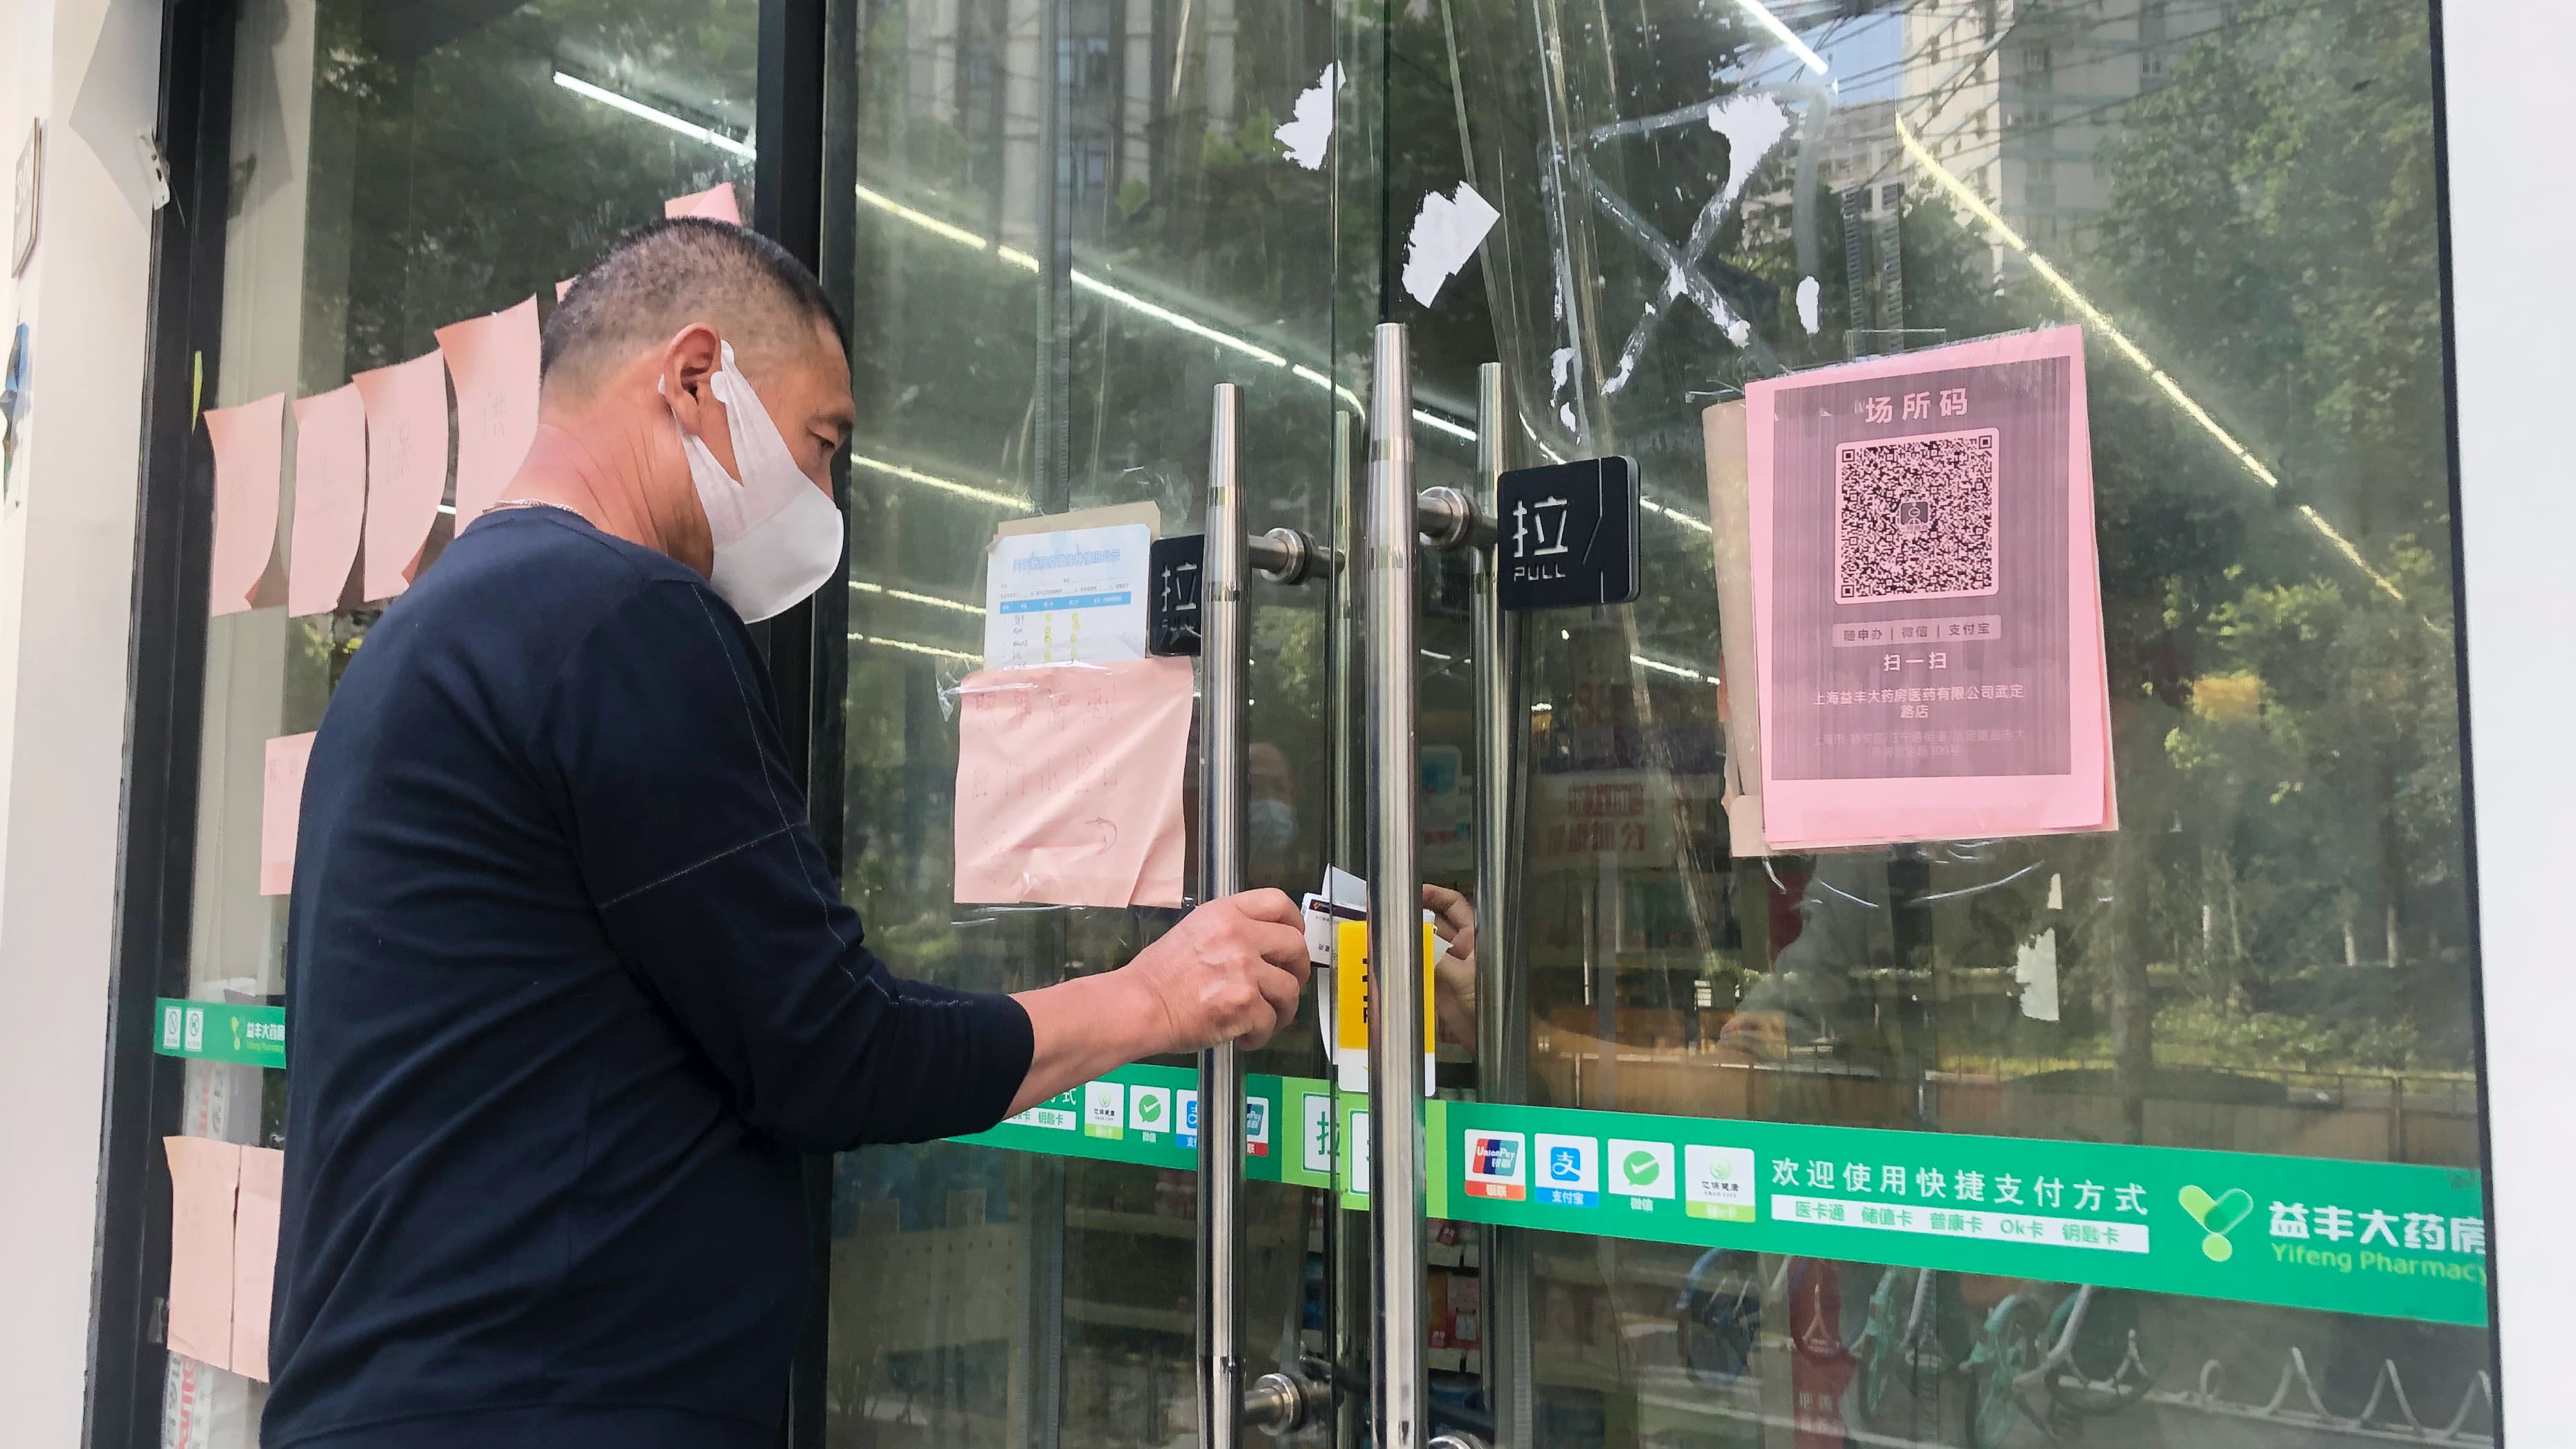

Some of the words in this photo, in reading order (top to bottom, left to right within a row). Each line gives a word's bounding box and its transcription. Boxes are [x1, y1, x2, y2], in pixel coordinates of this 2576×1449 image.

[1865, 388, 1968, 424] 场所码
[1512, 495, 1568, 558] 拉
[1514, 563, 1566, 582] PULL
[1161, 561, 1197, 612] 拉
[1844, 628, 1883, 642] 随申办
[1902, 625, 1928, 639] 微信
[1948, 622, 1990, 637] 支付宝
[1883, 652, 1947, 671] 扫一扫
[1813, 684, 2024, 706] 上海益丰大药房医药有限公司武定
[1901, 704, 1930, 719] 路店
[1477, 1146, 1515, 1160] UnionPay
[1552, 1190, 1584, 1205] 支付宝
[1772, 1158, 2148, 1215] 欢迎使用快捷支付方式
[1631, 1197, 1653, 1212] 微信
[1795, 1200, 1845, 1222] 医卡通
[1862, 1206, 1912, 1226] 储值卡
[1930, 1212, 1983, 1233] 普康卡
[2000, 1219, 2044, 1238] Ok卡
[2062, 1223, 2120, 1245] 钥匙卡
[2268, 1201, 2487, 1255] 益丰大药房
[2271, 1243, 2352, 1273] Yifeng
